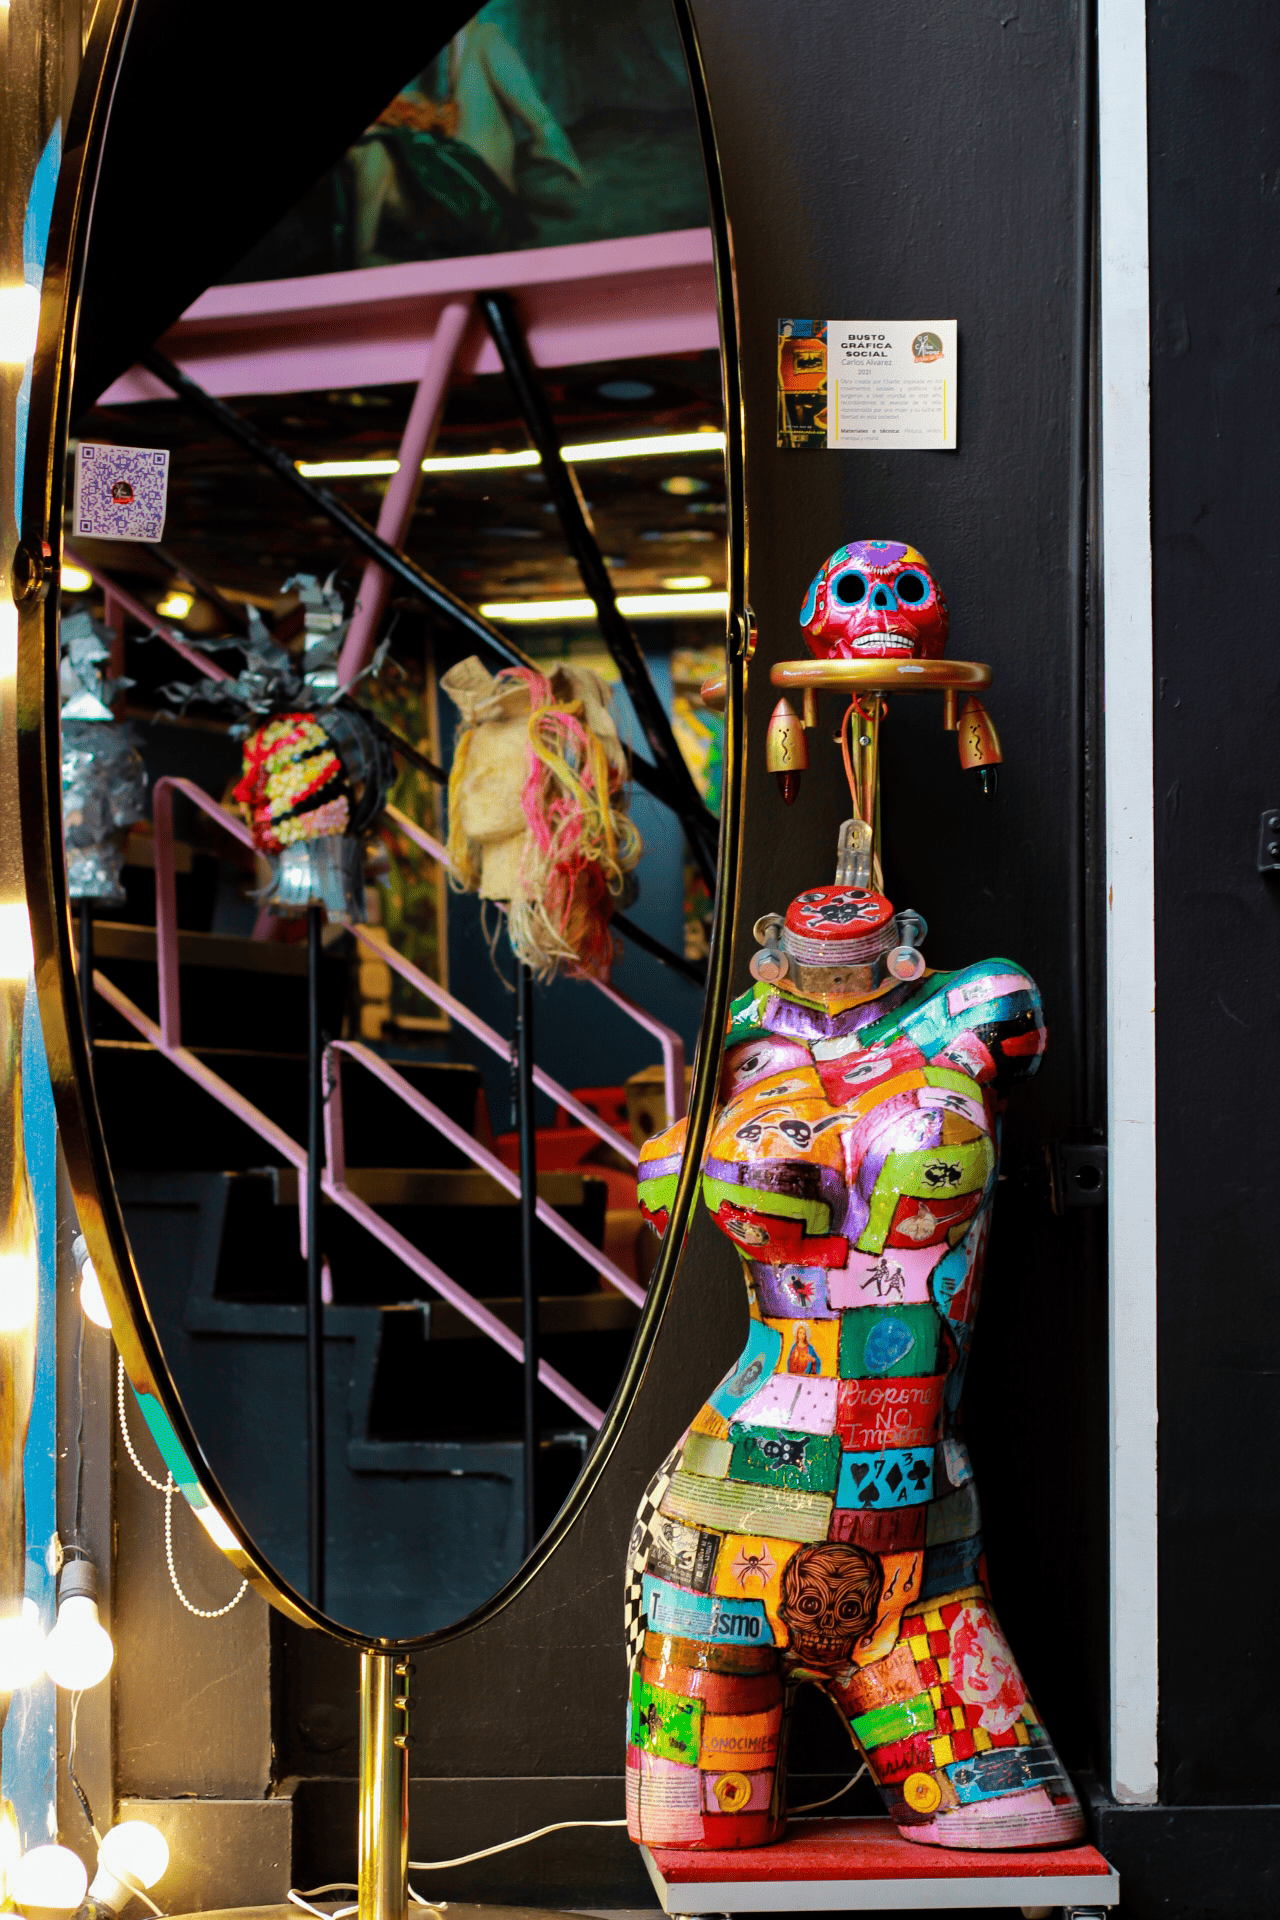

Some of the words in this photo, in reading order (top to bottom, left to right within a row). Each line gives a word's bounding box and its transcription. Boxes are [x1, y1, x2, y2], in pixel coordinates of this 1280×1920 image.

[839, 1380, 932, 1412] Propone
[876, 1407, 912, 1429] NO
[902, 1452, 913, 1466] 3
[874, 1460, 885, 1478] 7
[897, 1486, 907, 1502] A
